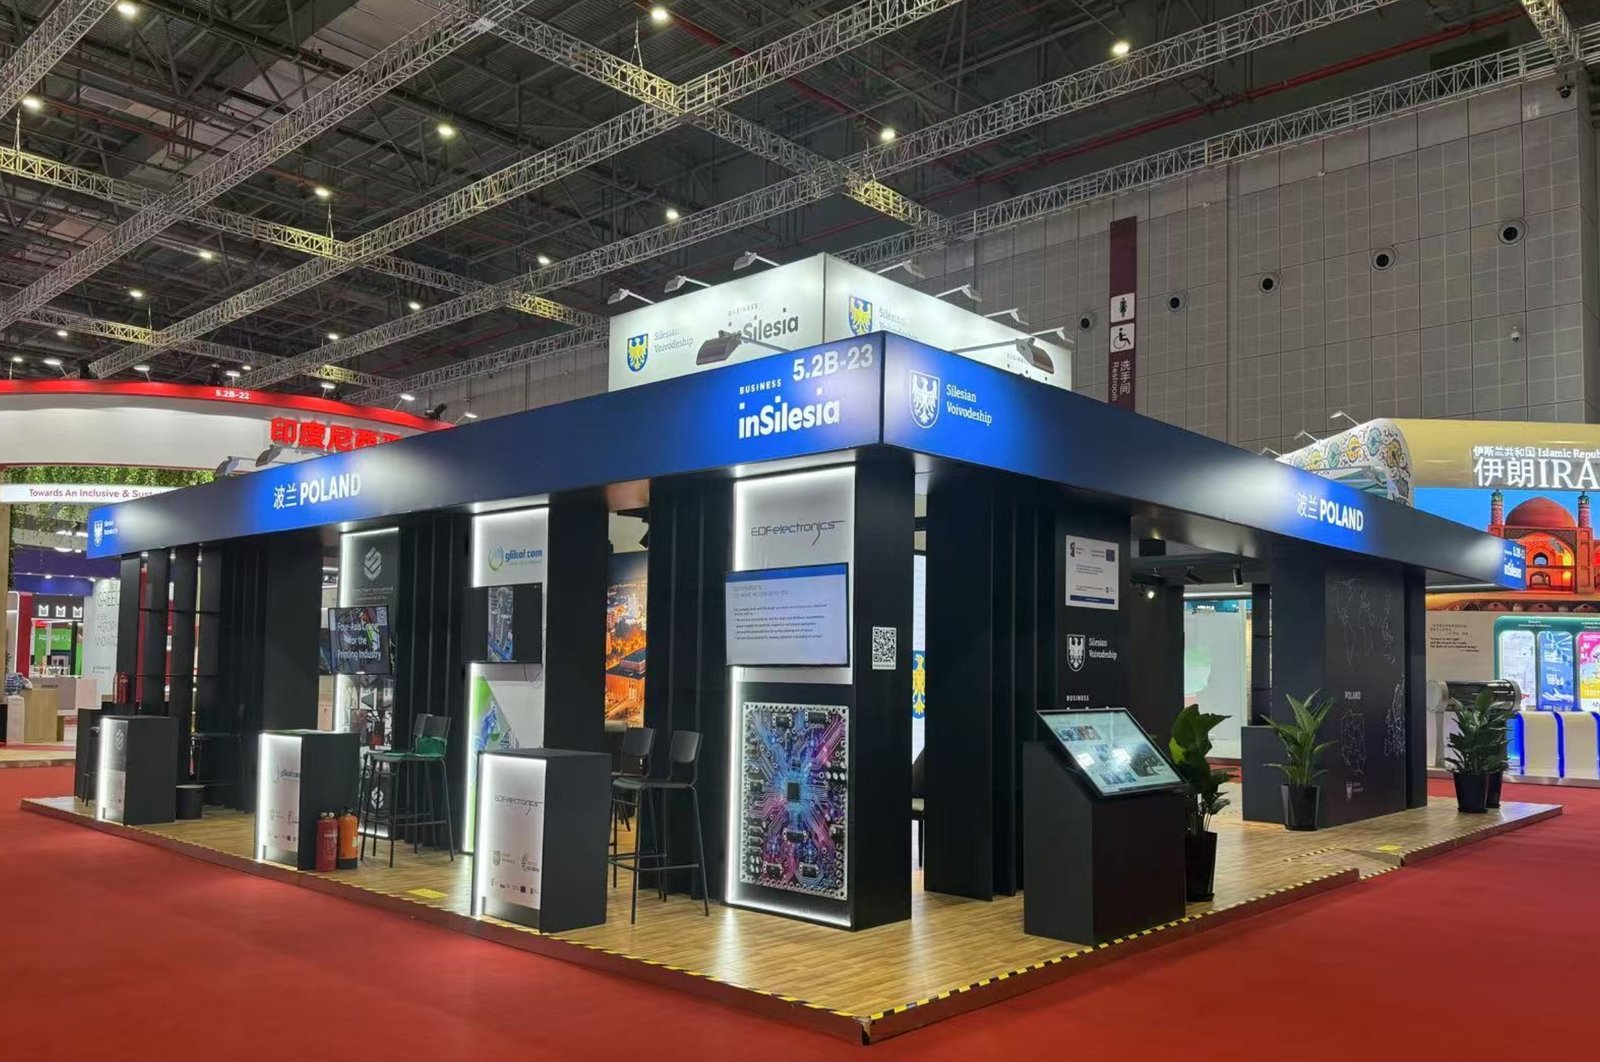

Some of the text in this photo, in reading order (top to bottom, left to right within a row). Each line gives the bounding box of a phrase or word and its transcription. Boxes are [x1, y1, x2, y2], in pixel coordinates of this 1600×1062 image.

[792, 343, 874, 382] 5.2B-23
[739, 379, 782, 395] BUSINESS
[1120, 360, 1131, 395] 洗手间
[215, 389, 250, 400] 5.2B-22
[946, 384, 977, 403] Silesian
[738, 387, 841, 439] inSilesia
[946, 402, 993, 426] Voivodeship
[1538, 448, 1572, 458] Islamic
[29, 488, 63, 497] Towards
[65, 489, 77, 497] An
[79, 489, 120, 498] Inclusive
[122, 489, 130, 498] &
[300, 473, 361, 506] POLAND
[1319, 499, 1364, 532] POLAND
